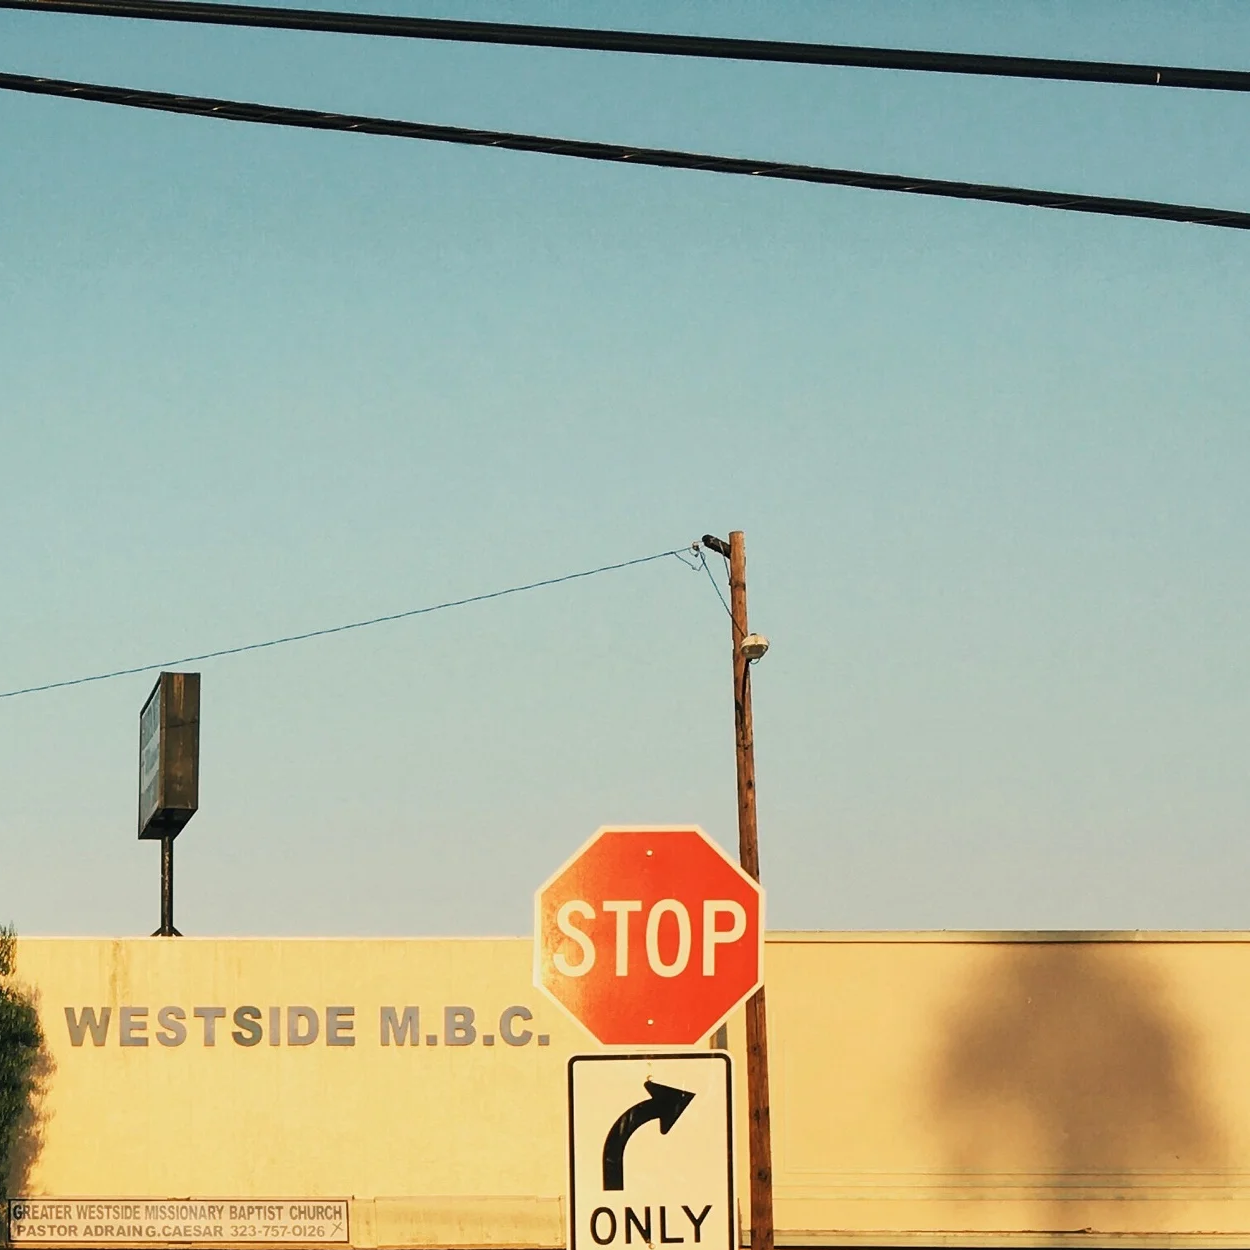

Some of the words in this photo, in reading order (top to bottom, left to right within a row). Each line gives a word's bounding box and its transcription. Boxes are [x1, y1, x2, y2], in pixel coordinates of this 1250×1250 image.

[553, 899, 747, 978] STOP
[64, 1005, 356, 1047] WESTSIDE
[380, 1005, 550, 1047] M.B.C.
[13, 1204, 72, 1220] GREATER
[76, 1204, 141, 1220] WESTSIDE
[145, 1205, 224, 1221] MISSIONARY
[229, 1205, 284, 1221] BAPTIST
[289, 1205, 343, 1221] CHURCH
[16, 1225, 78, 1237] PASTOR
[82, 1225, 143, 1237] ADRAIN
[590, 1204, 713, 1245] ONLY
